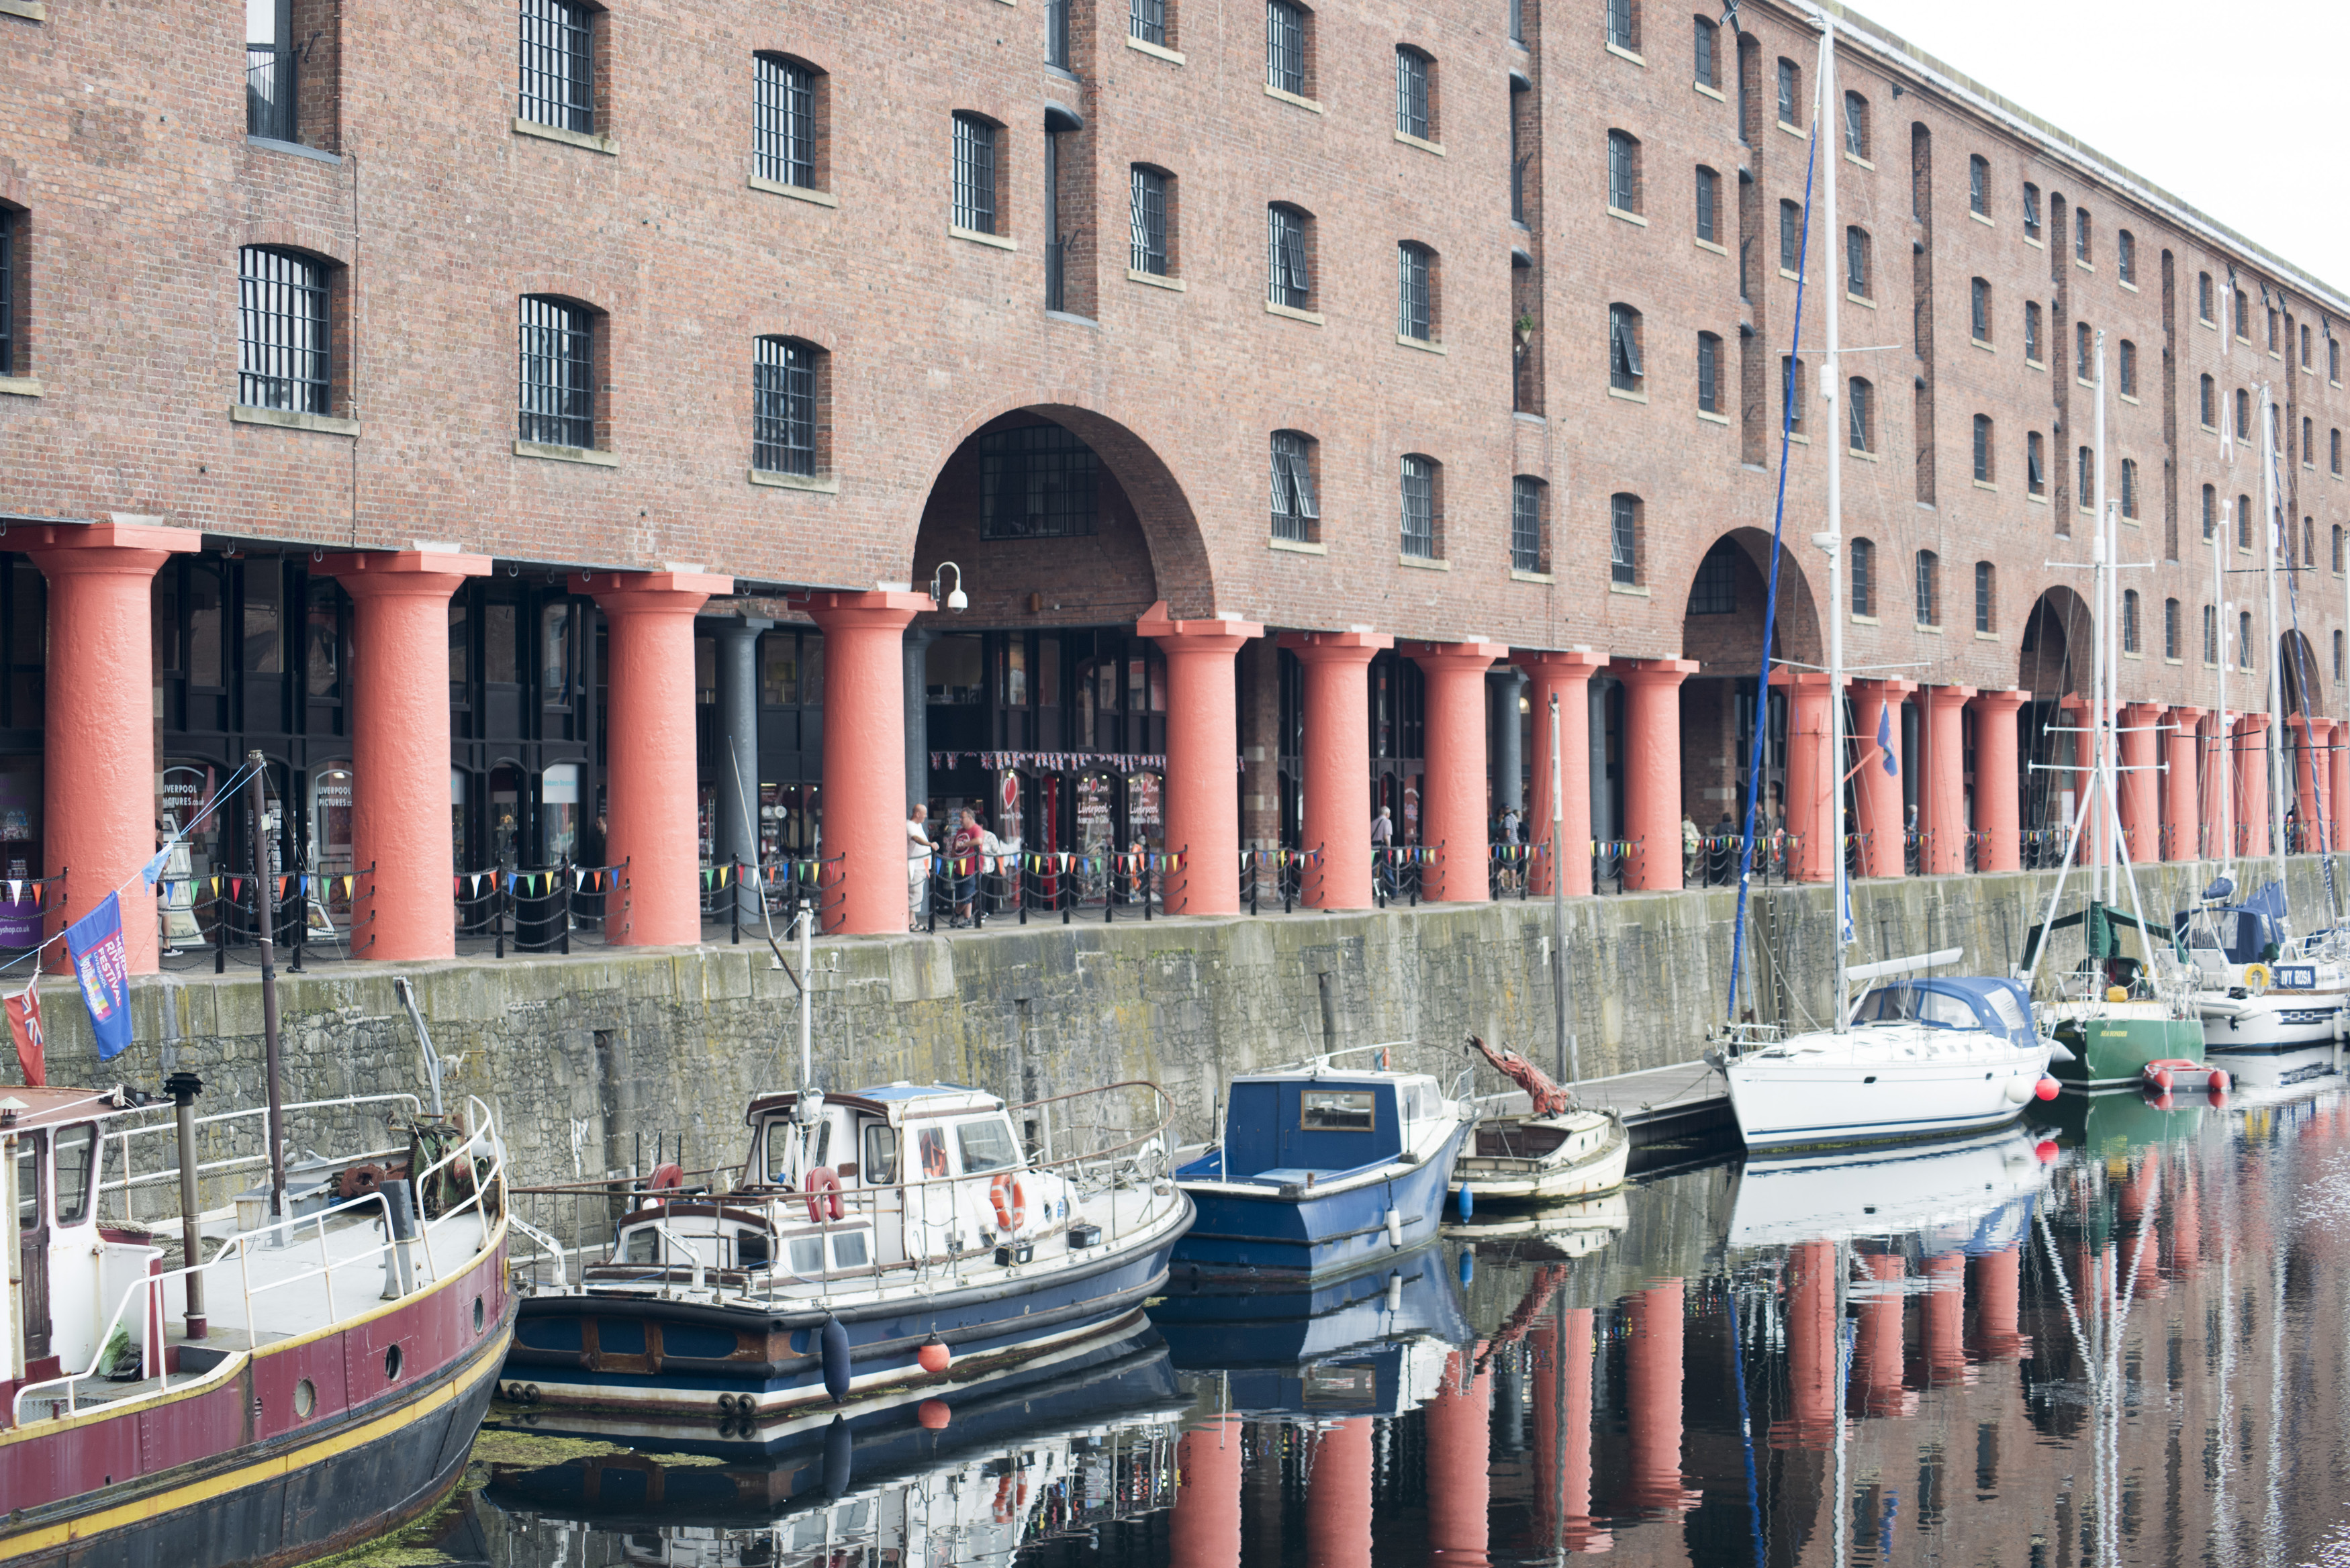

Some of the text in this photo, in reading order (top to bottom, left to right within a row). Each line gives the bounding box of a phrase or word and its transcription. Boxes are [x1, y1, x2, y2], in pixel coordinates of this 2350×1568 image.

[163, 784, 197, 793] IVERPOOL
[318, 786, 351, 795] LIVERPOOL
[1077, 783, 1109, 793] With Love
[1130, 783, 1141, 793] With
[1078, 801, 1109, 816] Liverpool
[1130, 802, 1159, 817] Liverpool
[105, 940, 122, 980] RIVER
[115, 935, 129, 985] MERSE
[93, 951, 108, 988] LIVERPOOL
[98, 946, 121, 1007] FESTIVAL
[2281, 969, 2312, 985] IVY ROSA
